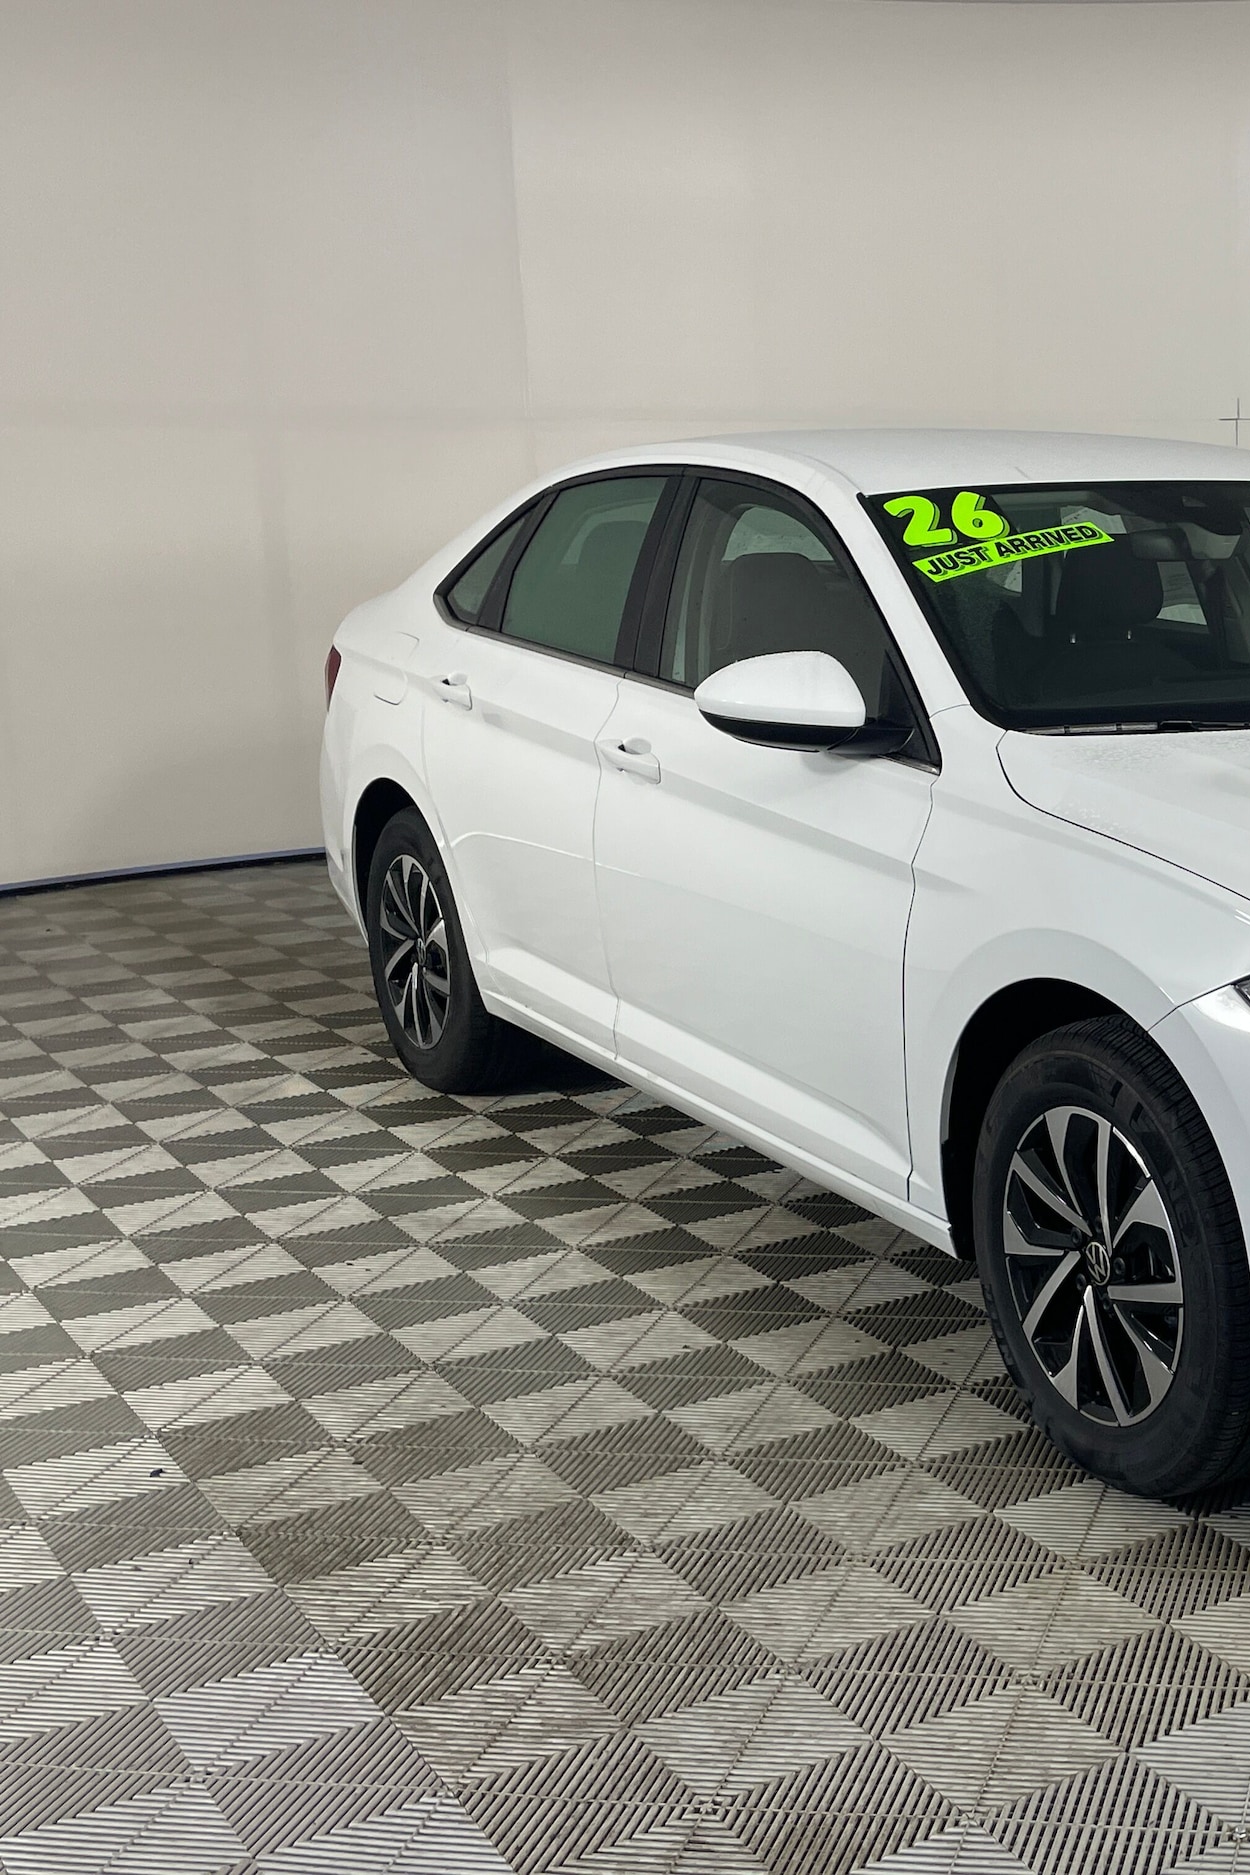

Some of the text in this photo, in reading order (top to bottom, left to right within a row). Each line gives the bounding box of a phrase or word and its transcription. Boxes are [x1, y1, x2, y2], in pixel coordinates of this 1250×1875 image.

[883, 491, 1010, 547] 26
[927, 525, 1104, 577] JUST ARRIVED
